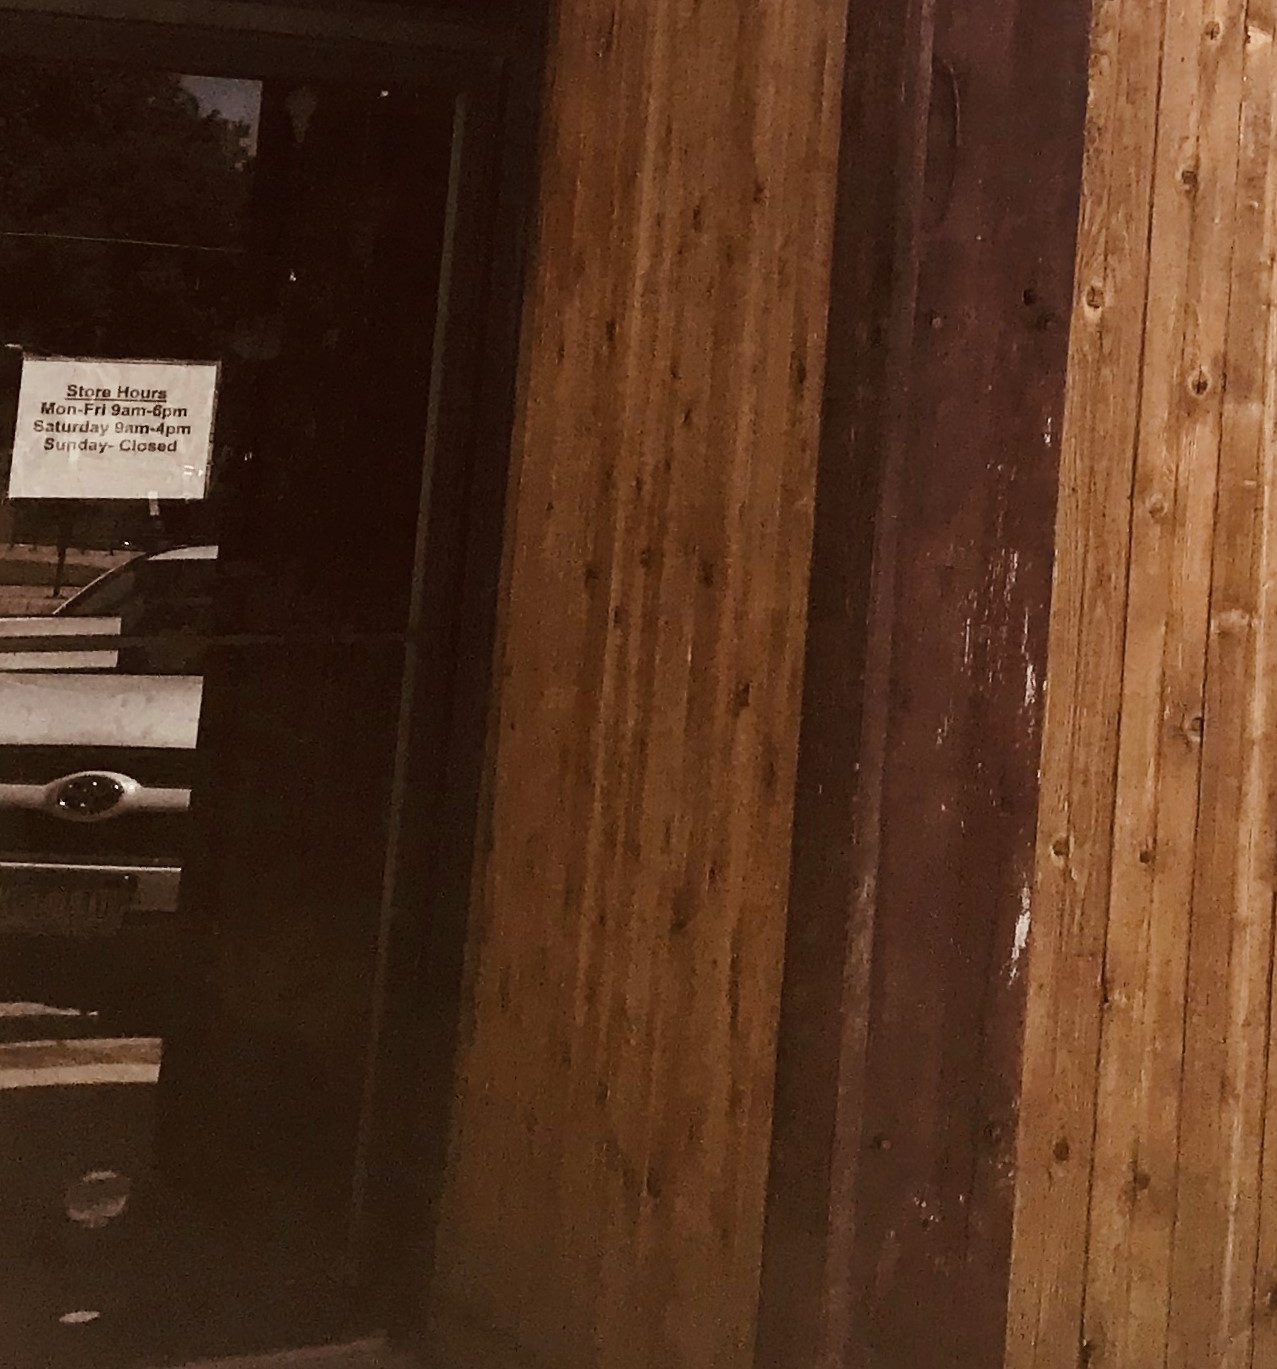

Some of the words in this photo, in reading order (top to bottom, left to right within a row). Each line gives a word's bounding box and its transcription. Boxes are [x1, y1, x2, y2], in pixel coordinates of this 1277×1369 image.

[66, 384, 111, 399] Store
[117, 385, 167, 400] Hours
[41, 402, 106, 416] Mon-Fri
[111, 403, 188, 419] 9am-6pm
[33, 420, 109, 436] Saturday
[114, 421, 191, 437] 9am-4pm
[119, 440, 178, 452] Closed
